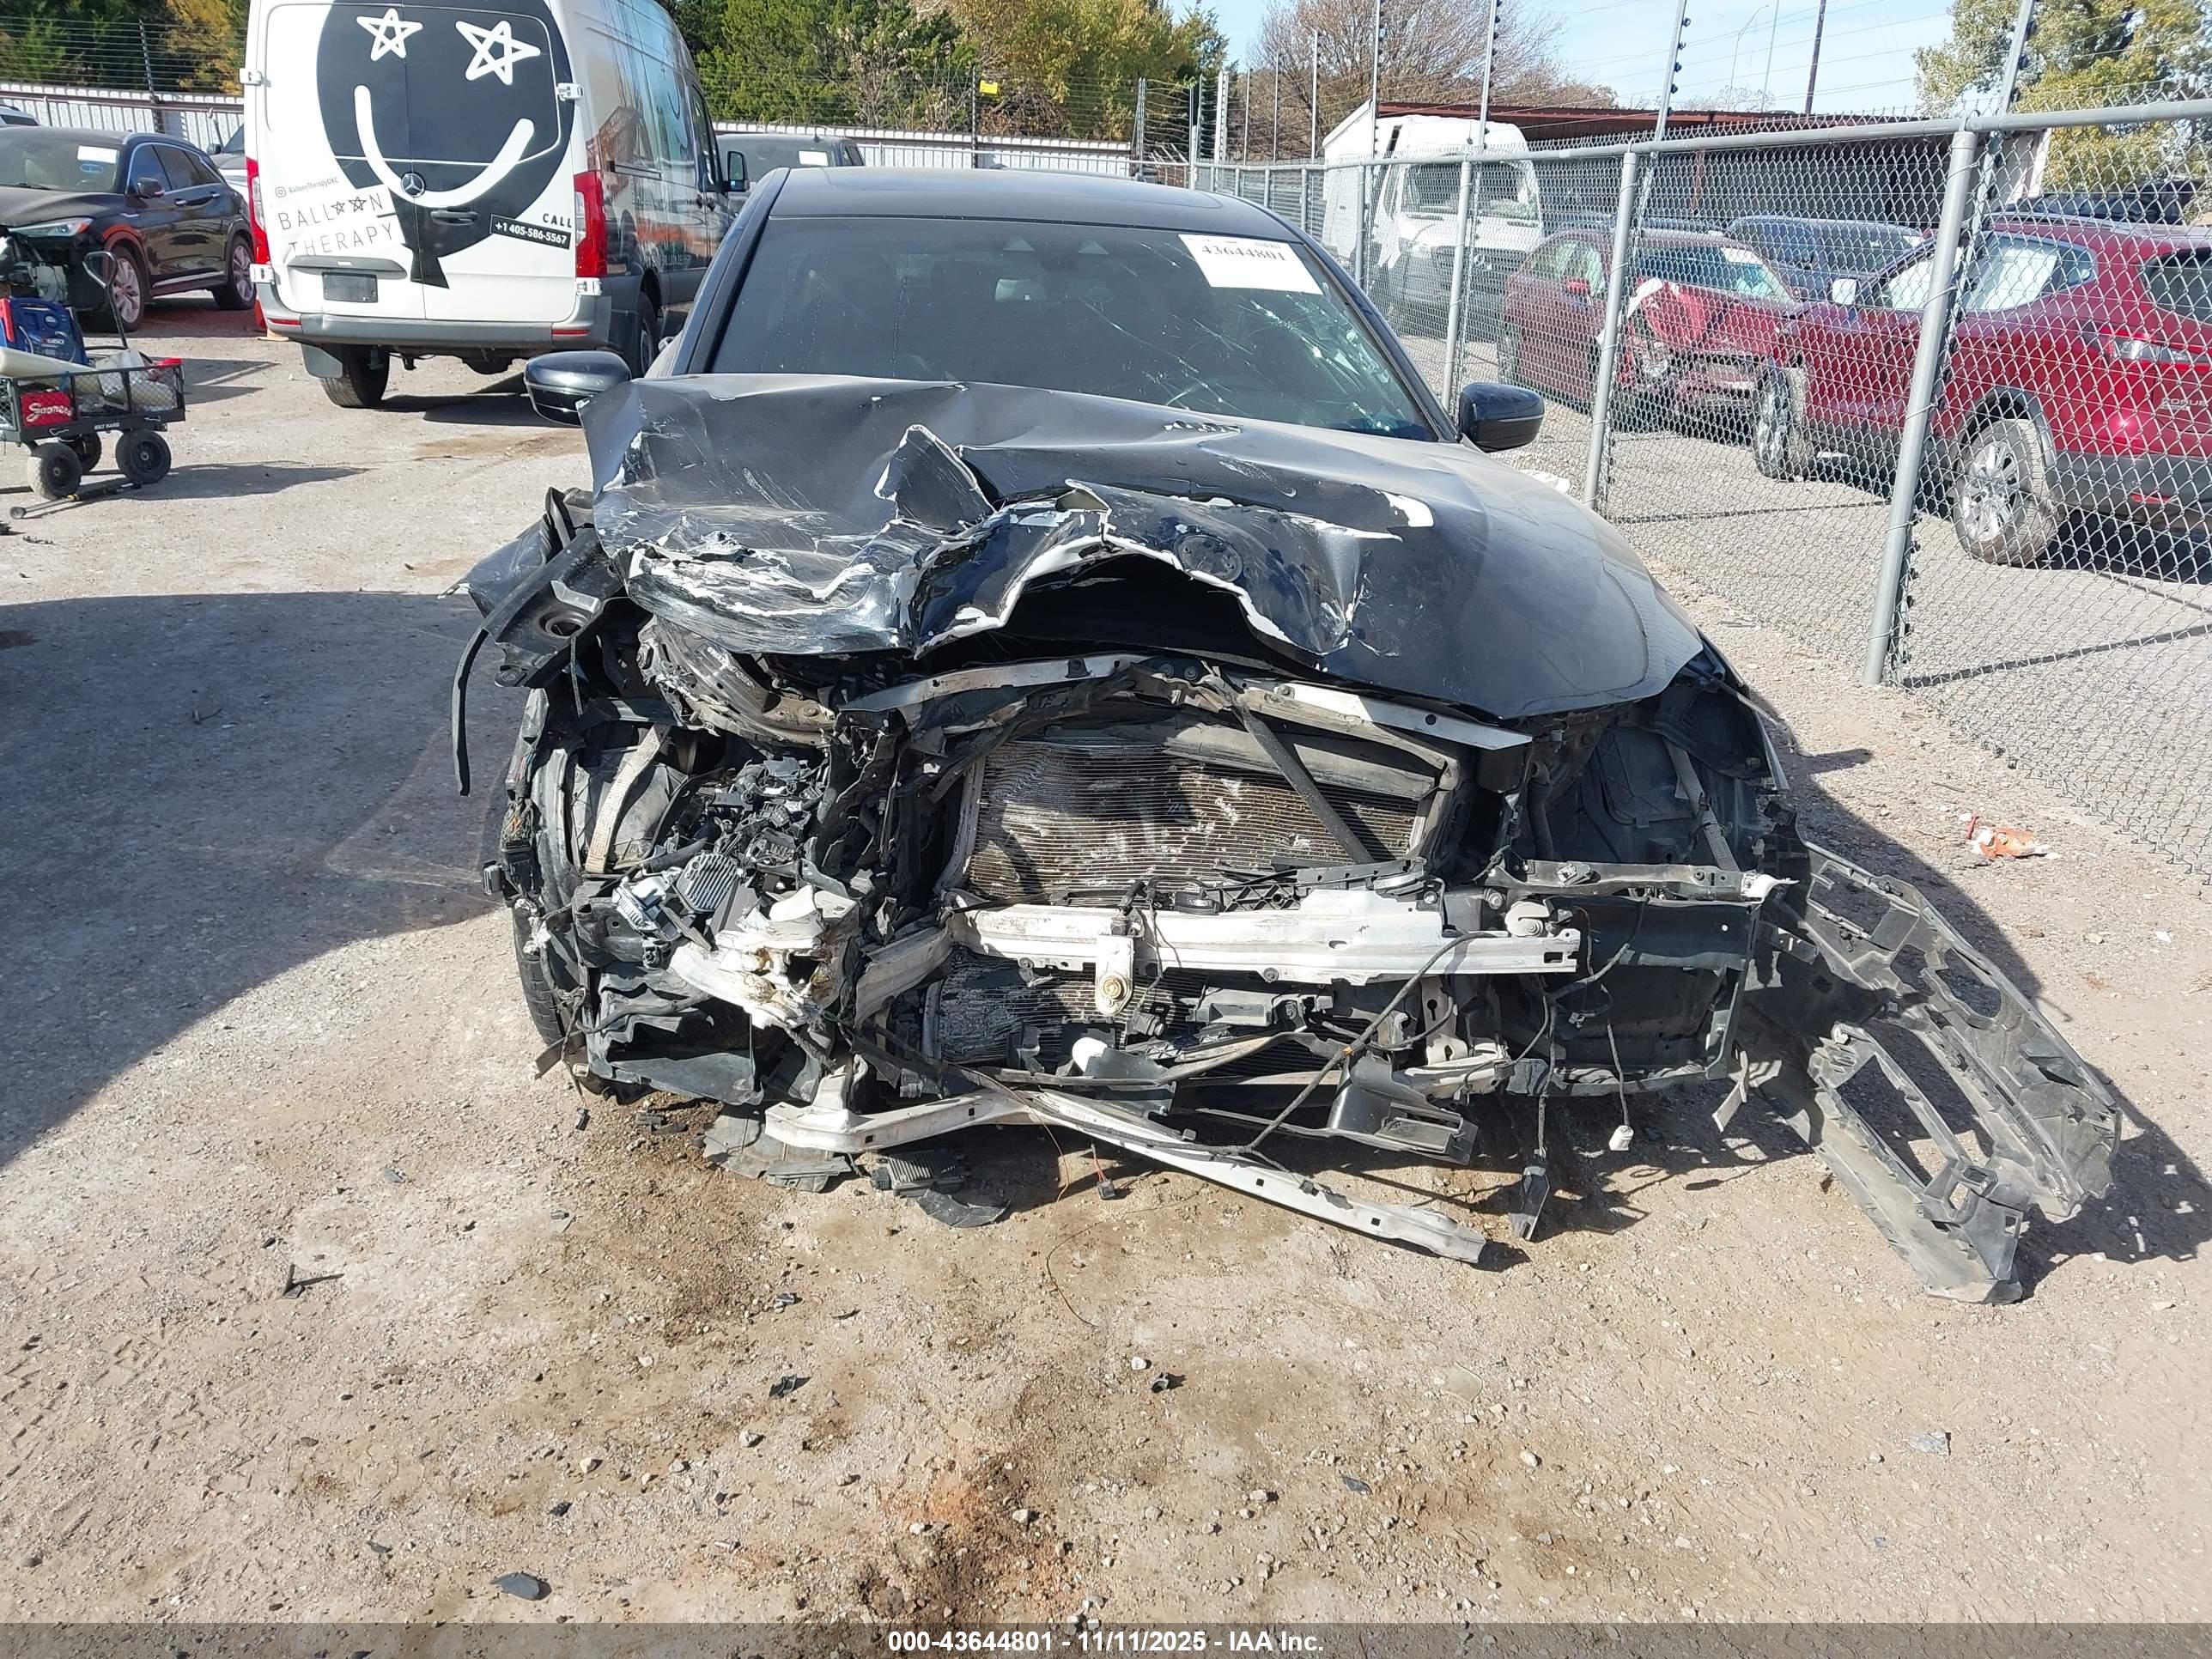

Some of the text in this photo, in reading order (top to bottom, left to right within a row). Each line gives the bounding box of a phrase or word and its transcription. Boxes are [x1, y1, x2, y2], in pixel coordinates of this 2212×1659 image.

[542, 213, 573, 228] CALL
[289, 222, 392, 257] THERAPY
[495, 221, 568, 245] +1 405-586-5567
[1201, 245, 1286, 261] 43644801
